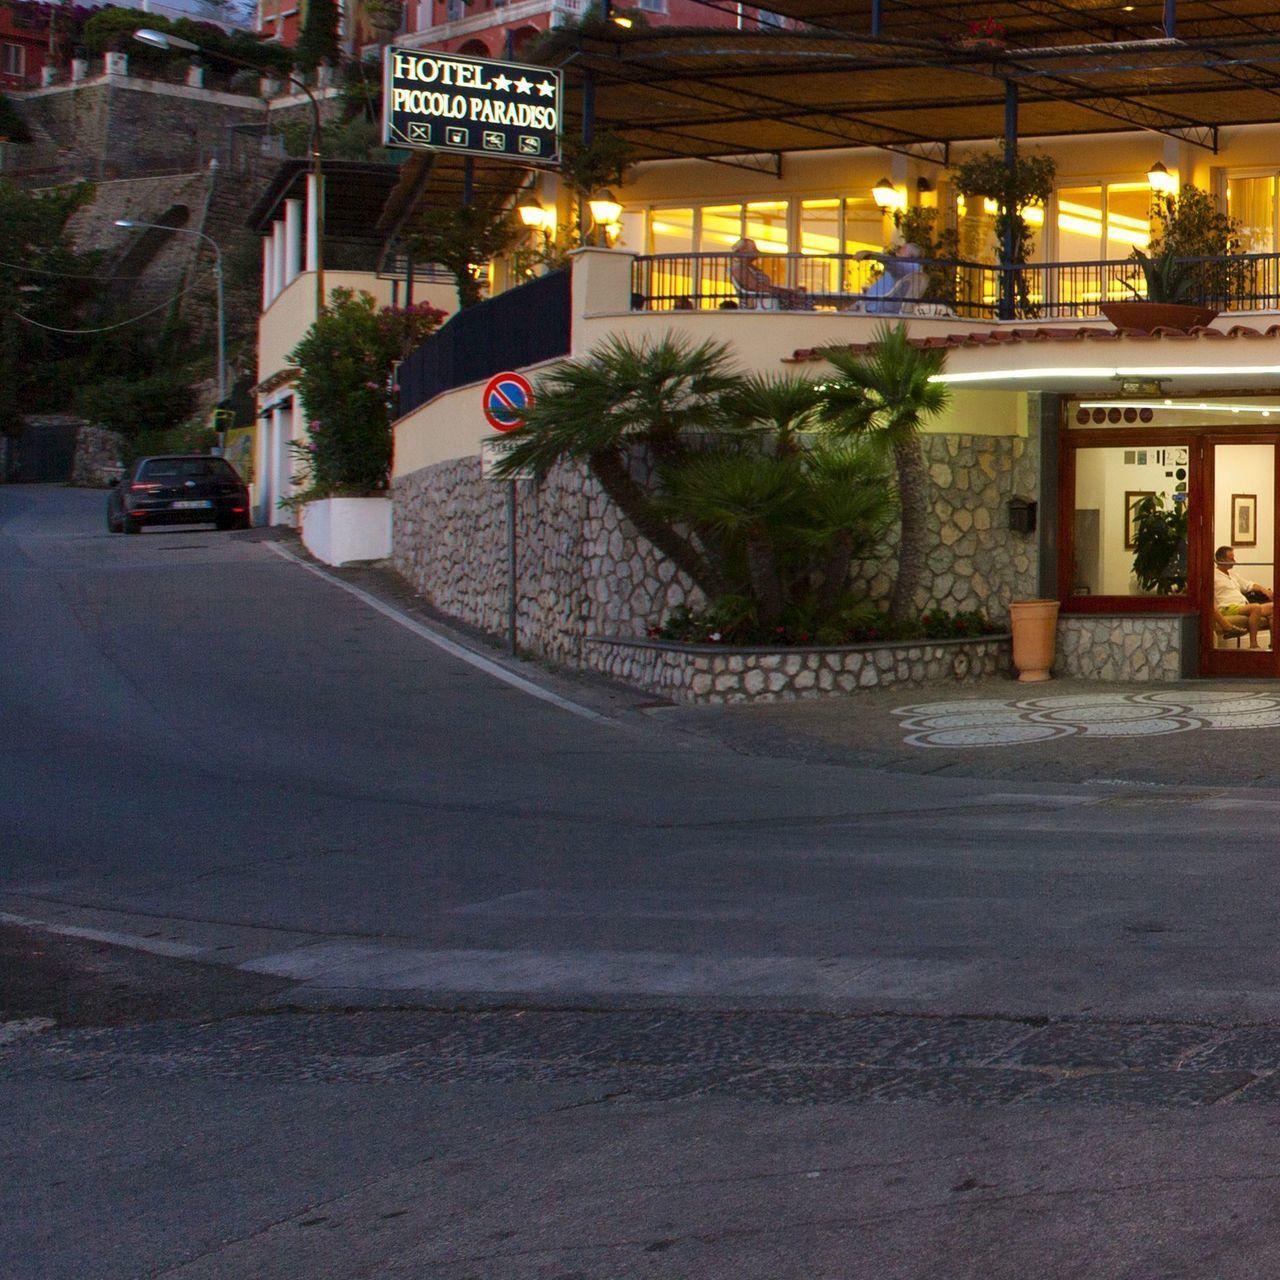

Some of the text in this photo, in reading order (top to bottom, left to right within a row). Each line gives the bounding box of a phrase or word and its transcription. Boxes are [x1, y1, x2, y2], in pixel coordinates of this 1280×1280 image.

[394, 55, 491, 90] HOTEL
[392, 88, 557, 130] PICCOLO PARADISO
